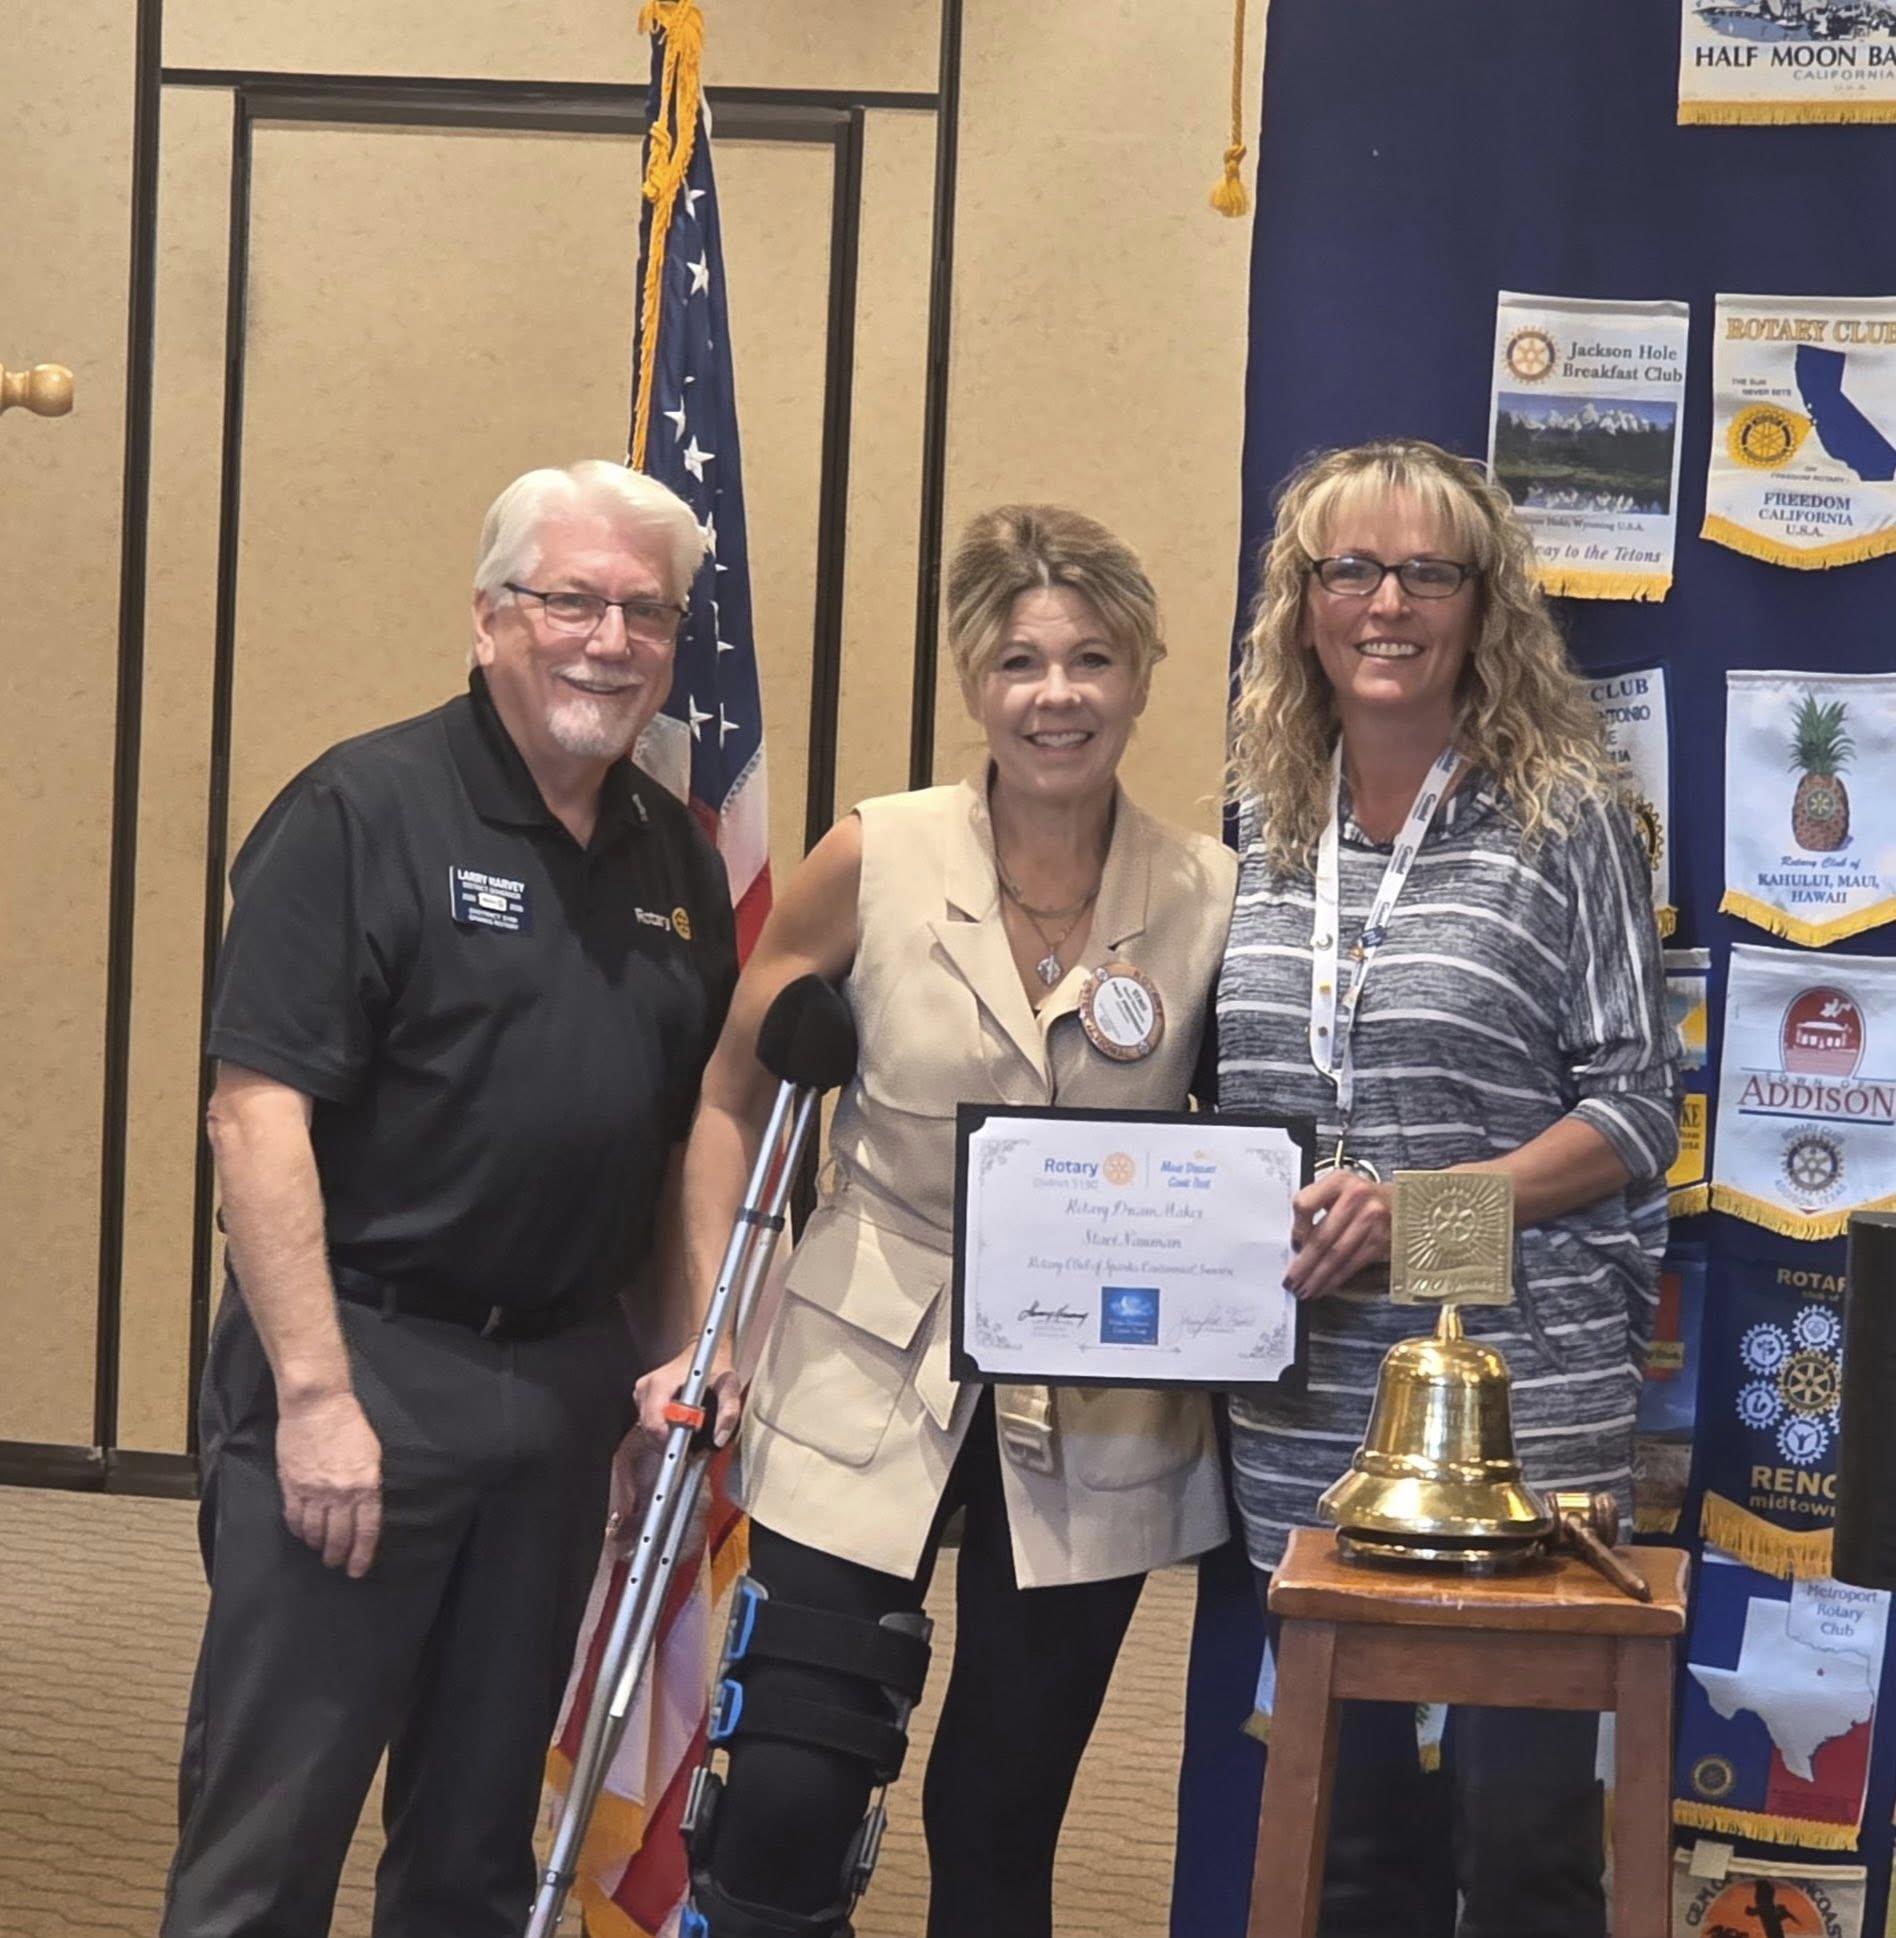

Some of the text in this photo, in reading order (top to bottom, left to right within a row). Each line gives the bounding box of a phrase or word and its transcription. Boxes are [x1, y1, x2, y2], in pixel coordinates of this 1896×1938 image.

[1696, 45, 1896, 67] HALF MOON BA
[1793, 69, 1895, 80] CALIFORNIA
[1726, 317, 1828, 342] ROTARY
[1567, 341, 1677, 361] Jackson Hole
[1562, 363, 1683, 382] Breakfast Club
[1763, 492, 1851, 511] FREEDOM
[1758, 508, 1853, 526] CALIFORNIA
[1785, 524, 1824, 538] U.S.A.
[1565, 543, 1580, 559] to
[1584, 543, 1609, 560] the
[1615, 545, 1662, 563] Tetons
[1590, 679, 1649, 702] CLUB
[1791, 890, 1848, 904] HAWAII
[1737, 1074, 1896, 1118] ADDISON
[1043, 1158, 1099, 1178] Rotary
[1776, 1268, 1847, 1293] ROTAR
[1816, 1604, 1865, 1623] Rotary
[1820, 1622, 1855, 1638] Club
